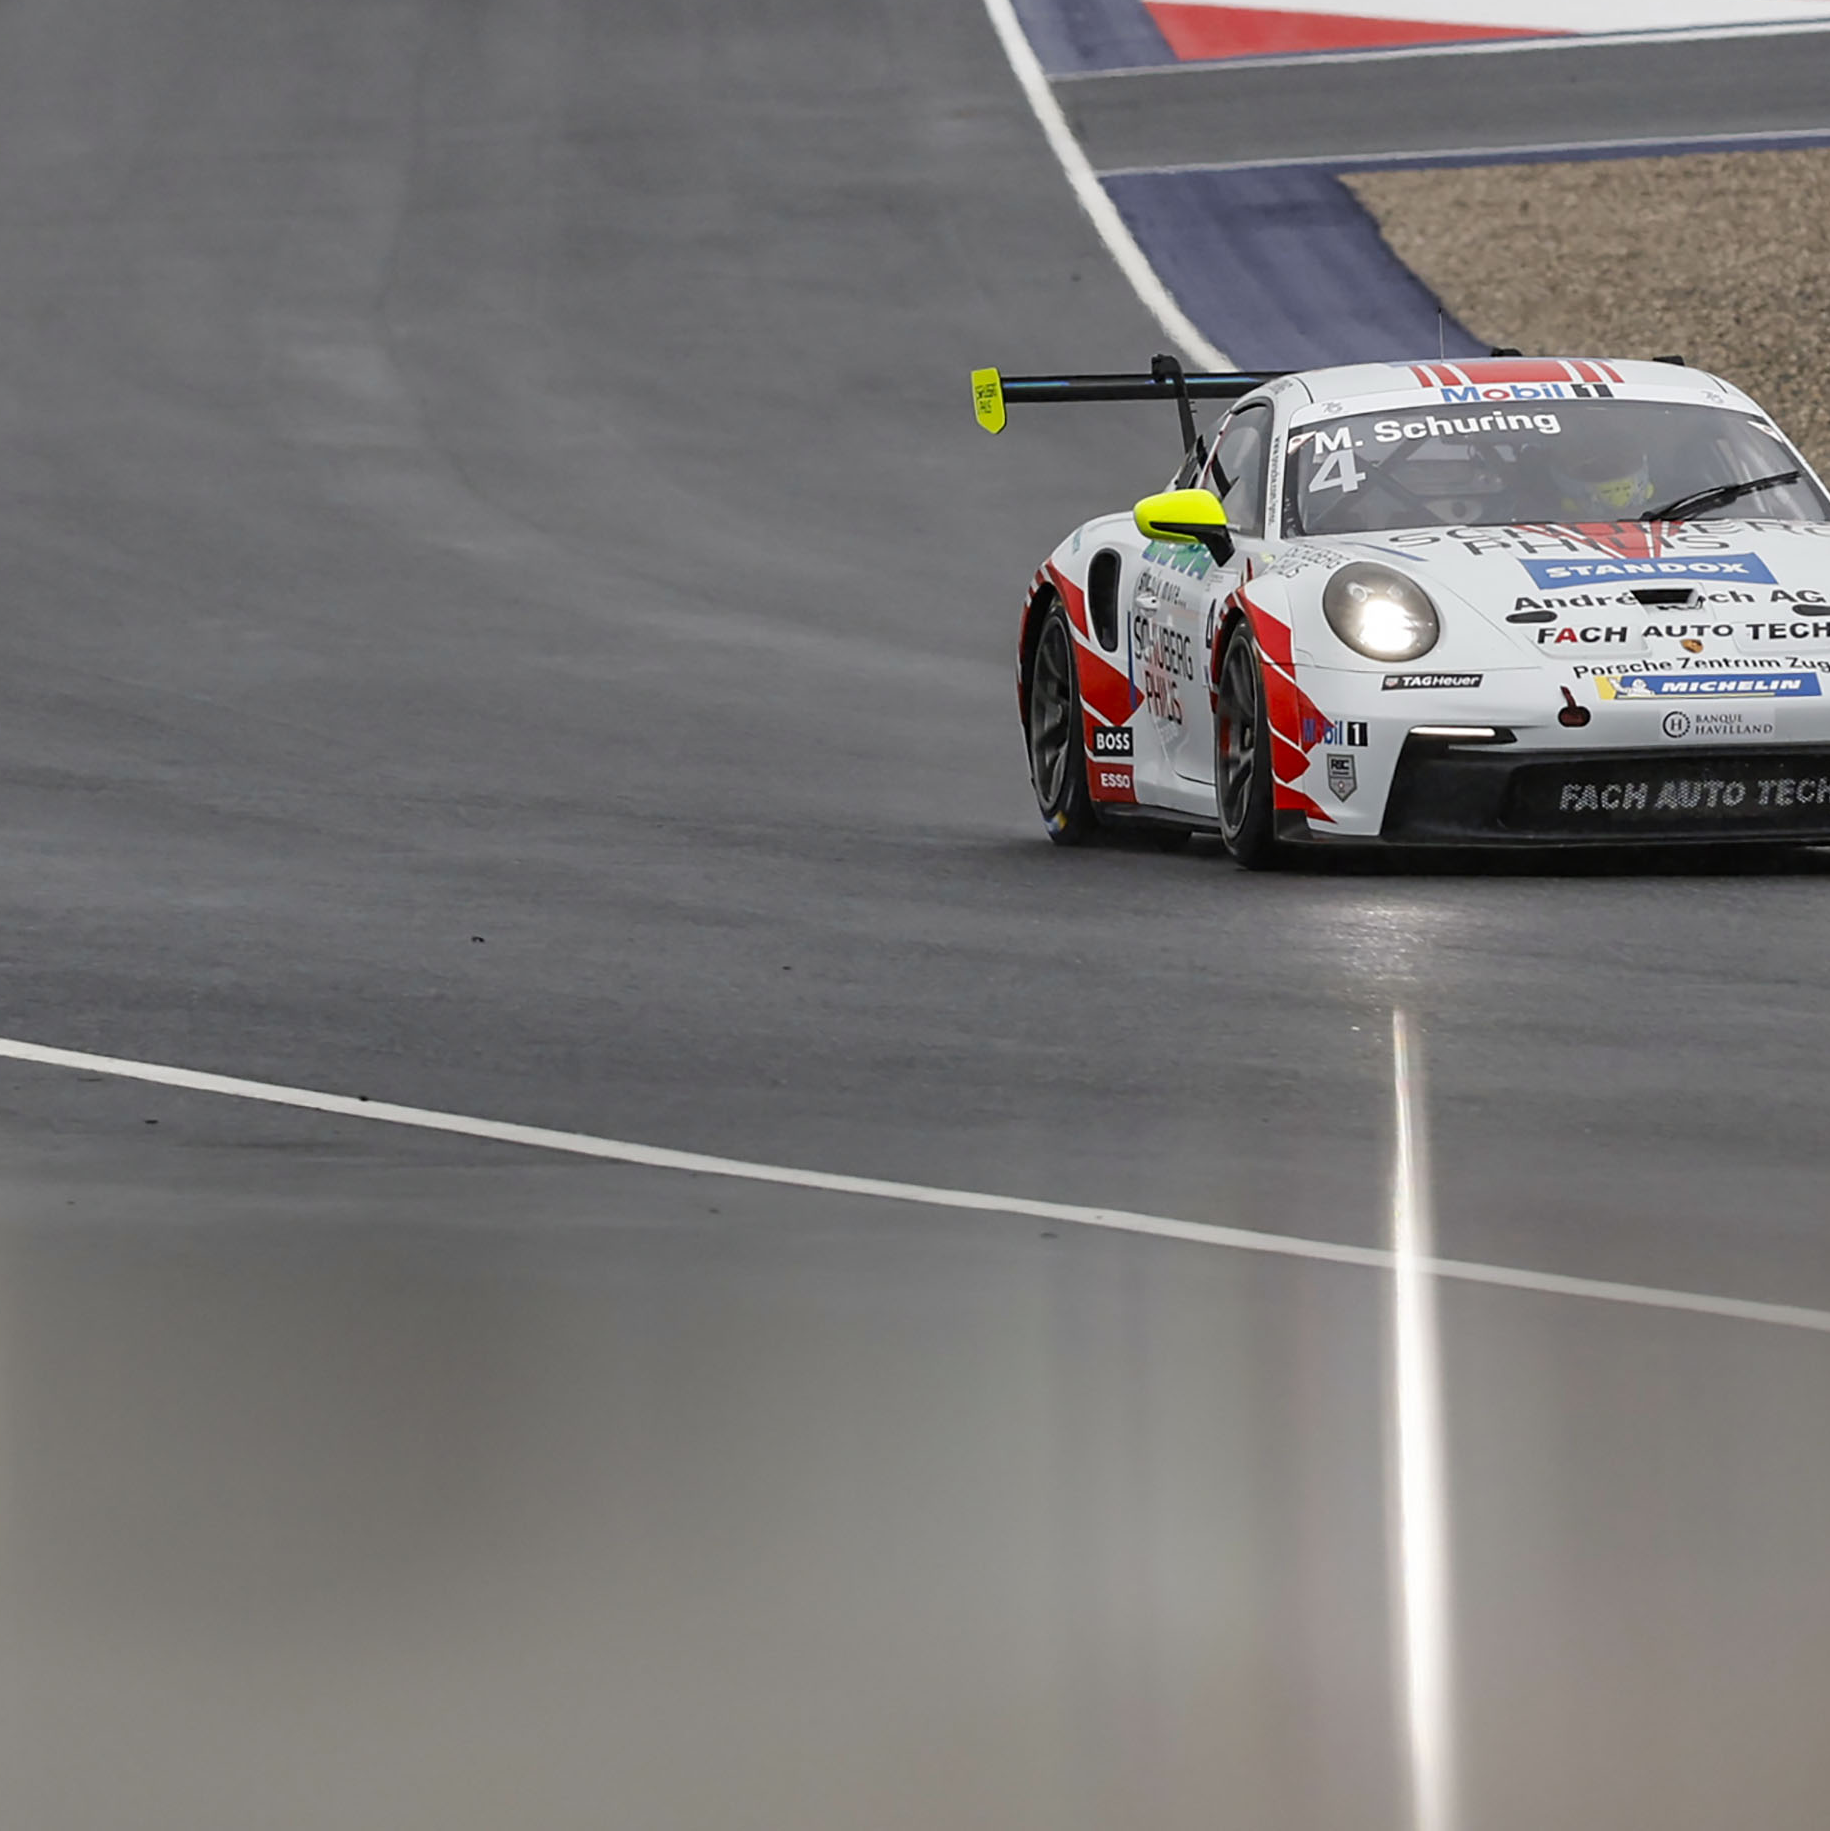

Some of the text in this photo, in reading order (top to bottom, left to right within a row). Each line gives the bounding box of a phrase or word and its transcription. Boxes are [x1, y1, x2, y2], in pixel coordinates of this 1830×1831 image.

[1441, 383, 1565, 402] Mobil
[1315, 411, 1562, 454] M. Schuring
[1308, 450, 1367, 494] 4
[1545, 562, 1750, 580] STANDOX
[1514, 591, 1637, 611] André
[1770, 589, 1827, 603] AG
[1537, 626, 1628, 644] FACH
[1643, 624, 1733, 637] AUTO
[1572, 658, 1672, 679] Porsche
[1676, 656, 1780, 670] Zentrum
[1661, 679, 1802, 693] MICHELIN
[1696, 714, 1743, 724] BANQUE
[1302, 717, 1343, 746] Mbil
[1695, 724, 1773, 735] HAVILLAND
[1096, 733, 1130, 750] BOSS
[1559, 782, 1648, 811] FACH
[1654, 780, 1746, 809] AUTO
